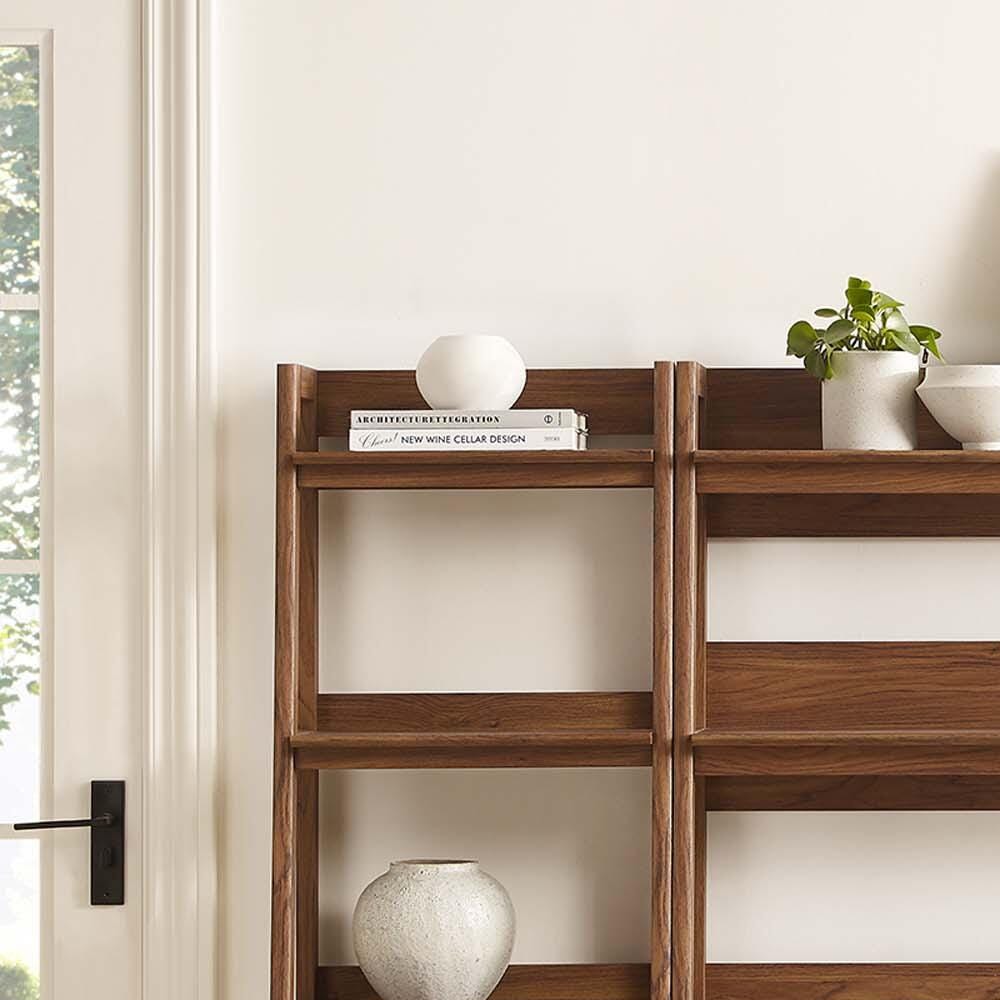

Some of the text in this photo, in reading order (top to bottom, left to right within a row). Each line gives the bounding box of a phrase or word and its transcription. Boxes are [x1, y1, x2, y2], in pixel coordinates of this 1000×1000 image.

[401, 434, 424, 444] NEW
[426, 434, 451, 444] WINE
[453, 434, 488, 444] CELLAR
[490, 434, 526, 444] DESIGN
